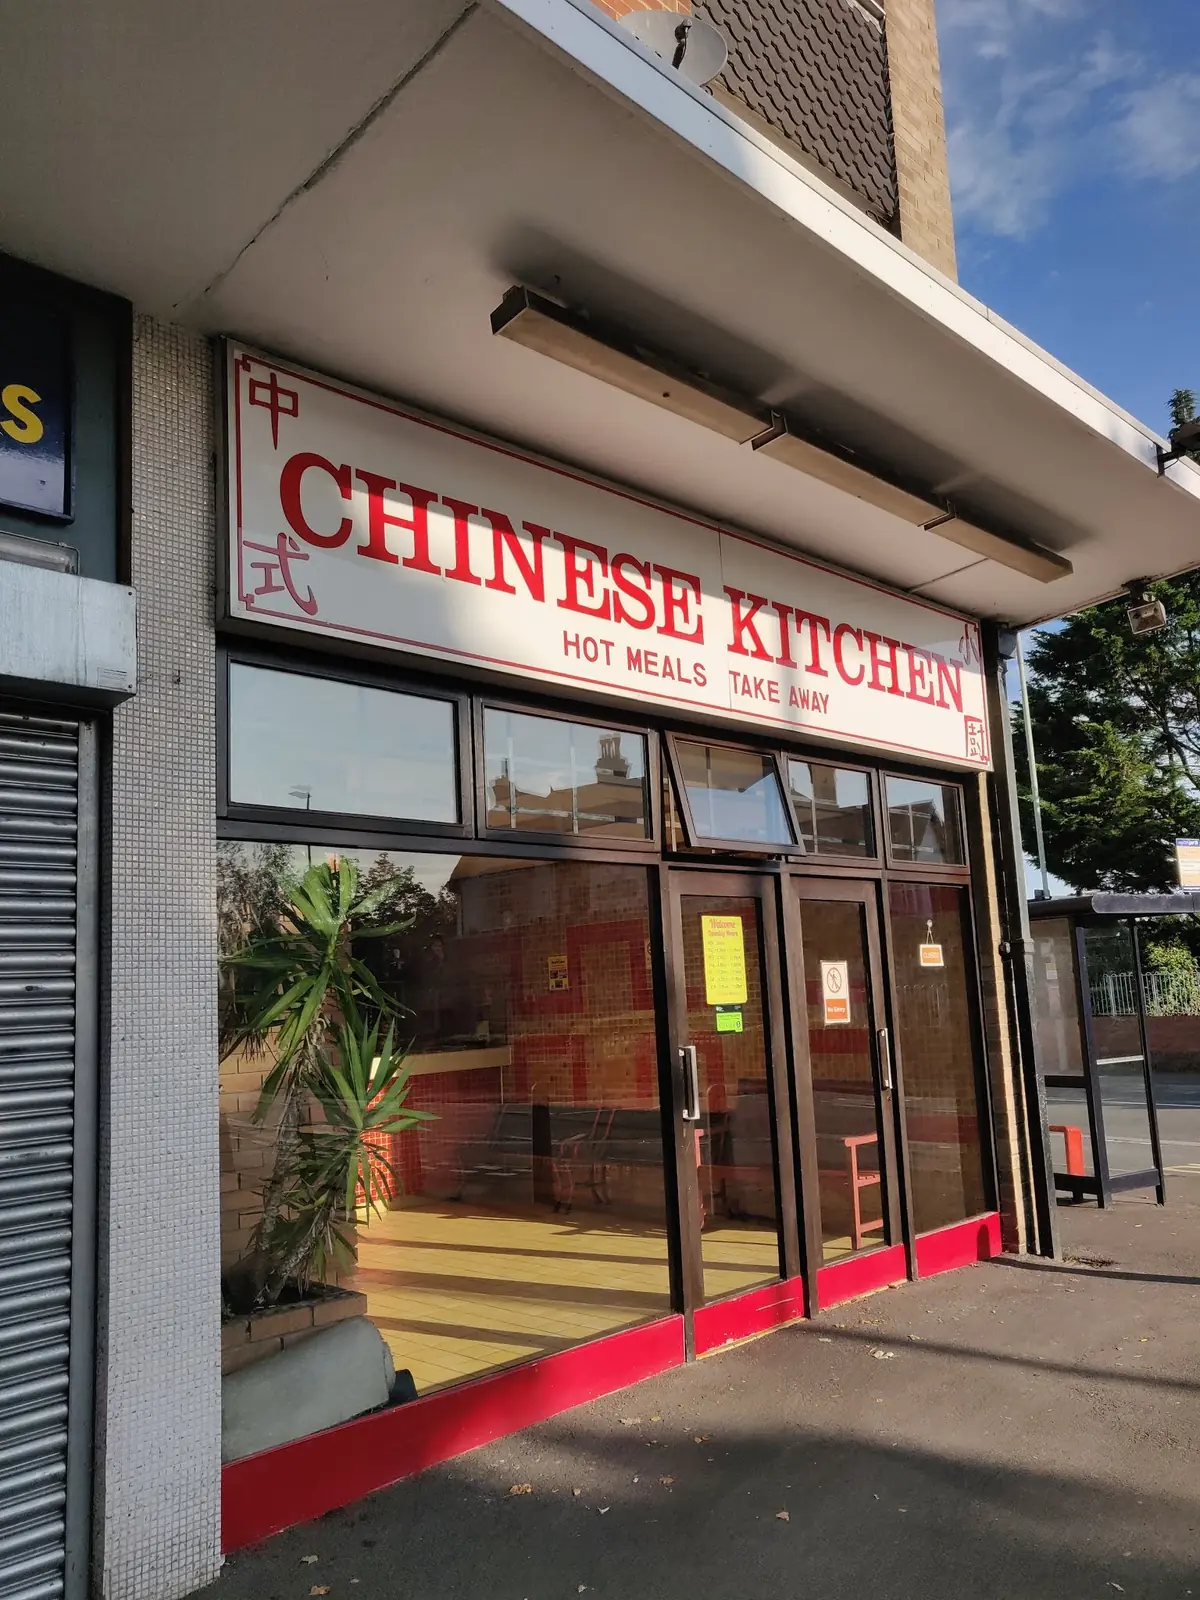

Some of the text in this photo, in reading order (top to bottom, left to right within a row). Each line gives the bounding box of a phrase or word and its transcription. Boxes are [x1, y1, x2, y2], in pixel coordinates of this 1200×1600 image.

[280, 452, 963, 713] CHINESE KITCHEN
[563, 630, 830, 714] HOT MEALS TAKE AWAY
[709, 918, 736, 928] Welcome
